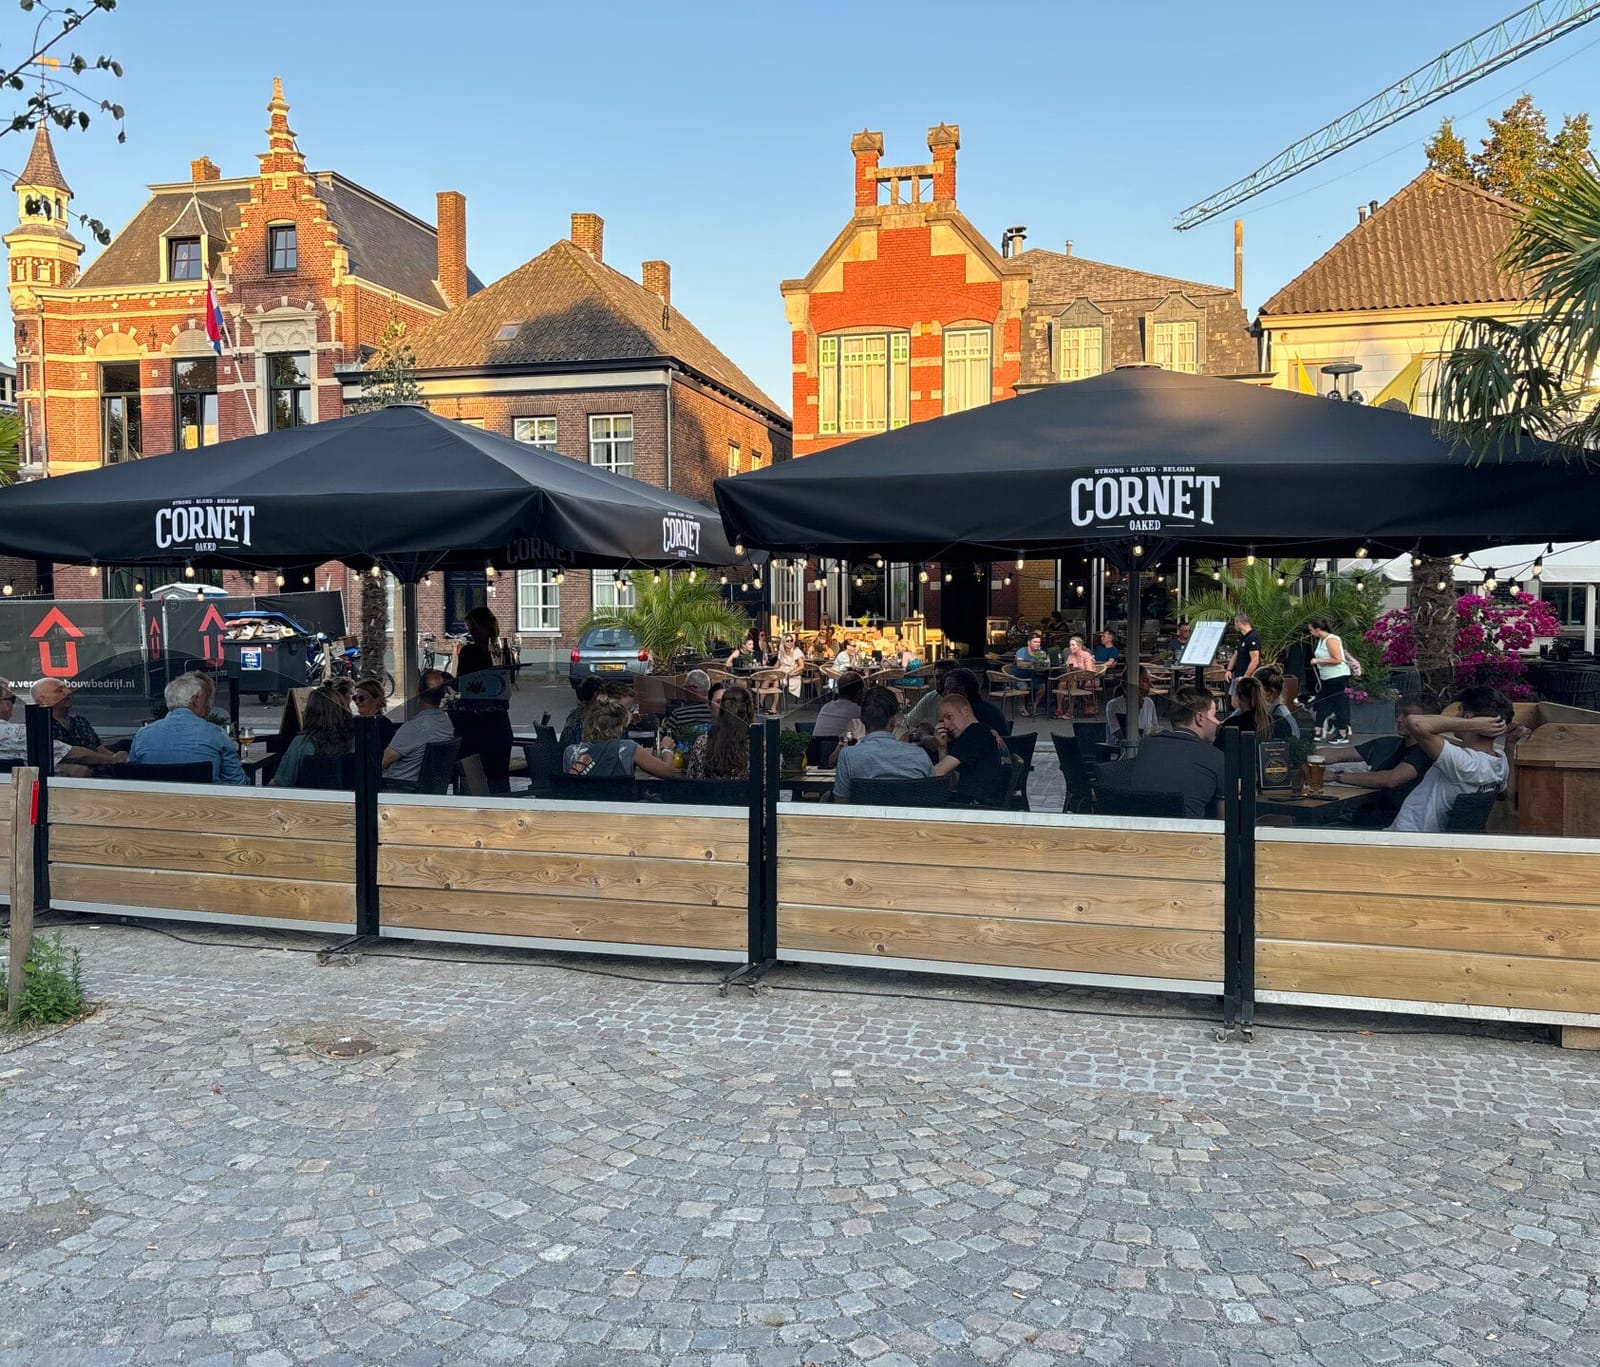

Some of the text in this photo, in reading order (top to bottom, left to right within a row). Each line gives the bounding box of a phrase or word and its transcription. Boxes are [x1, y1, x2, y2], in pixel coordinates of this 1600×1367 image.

[1070, 475, 1221, 527] CORNET
[155, 506, 255, 549] CORNET
[662, 517, 701, 556] CORNET
[1129, 519, 1161, 531] OAKED
[506, 535, 577, 565] CORNET
